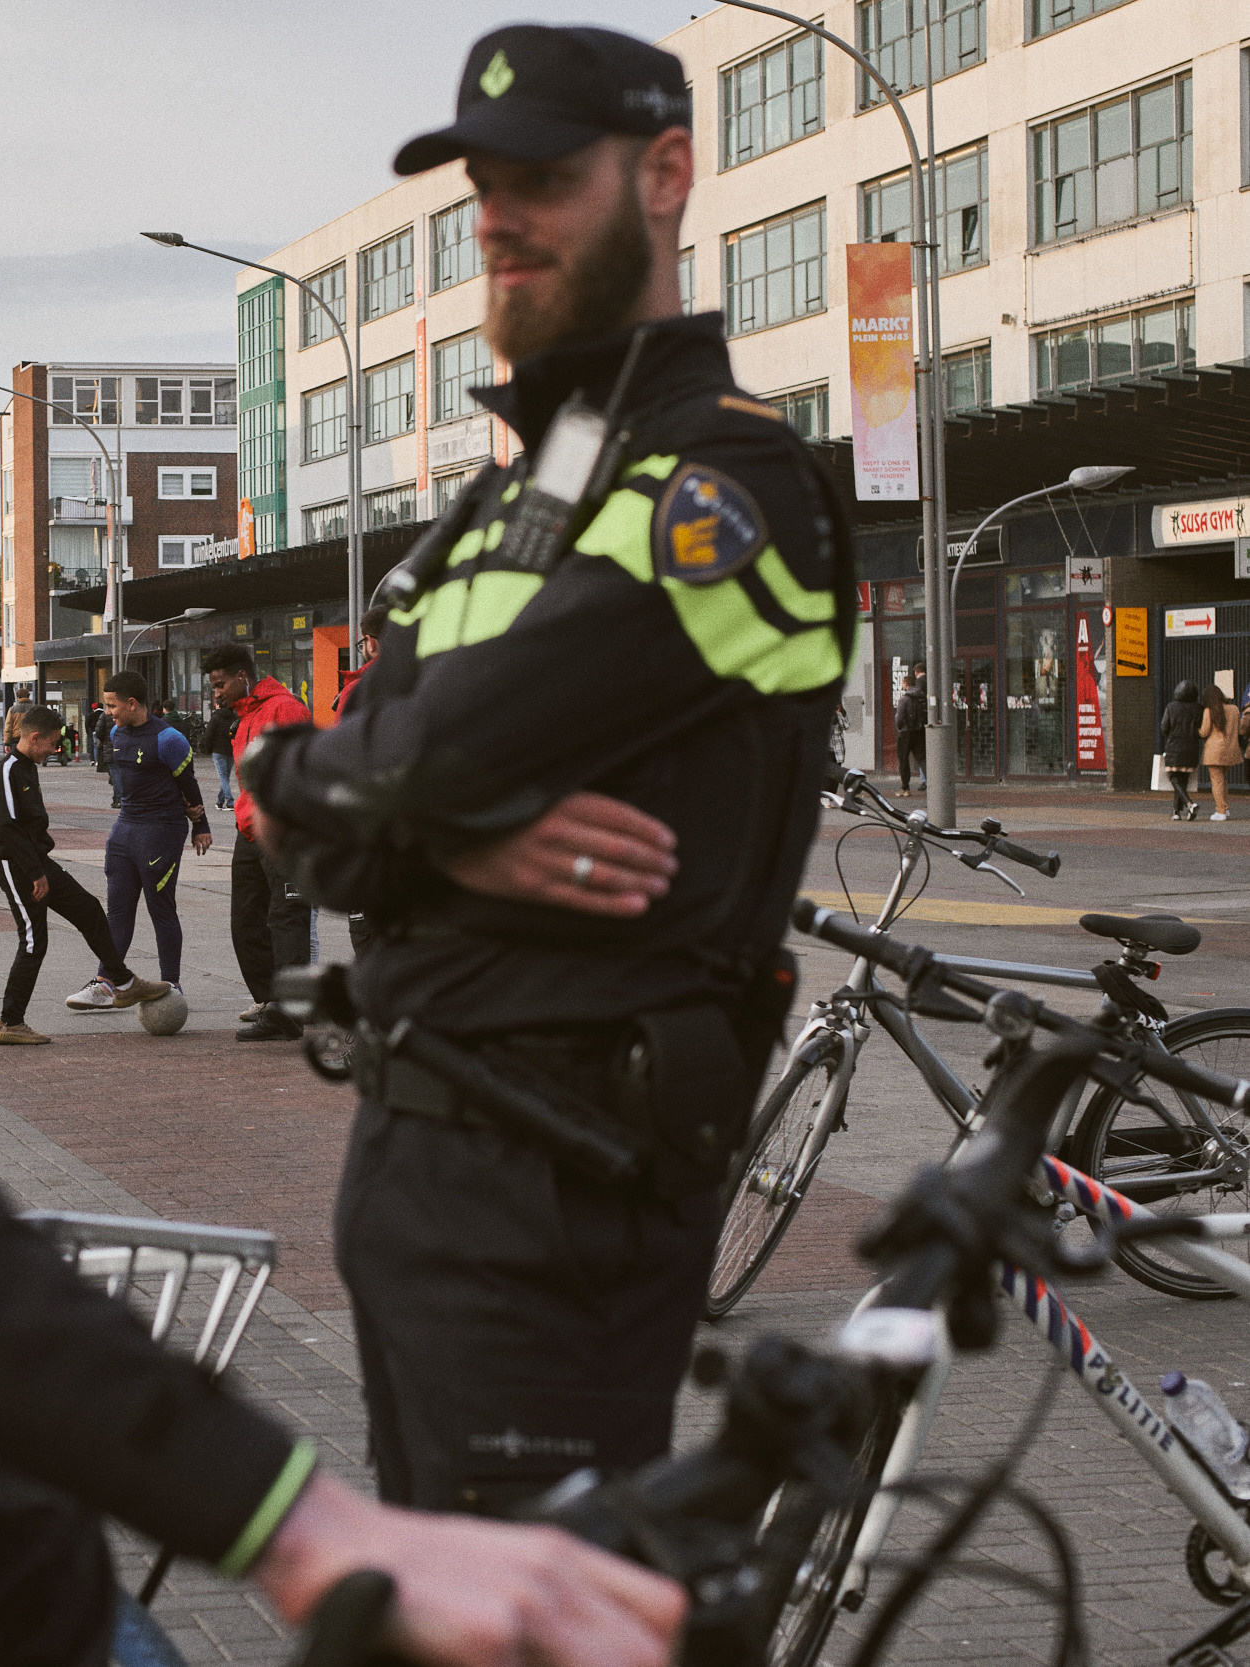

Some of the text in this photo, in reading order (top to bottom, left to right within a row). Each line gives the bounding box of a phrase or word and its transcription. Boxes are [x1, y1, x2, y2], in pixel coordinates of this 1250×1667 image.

[852, 317, 910, 332] MARKT
[853, 334, 878, 342] PLEIN
[1181, 509, 1234, 533] SUSA GYM
[1088, 1352, 1174, 1452] POLITIE
